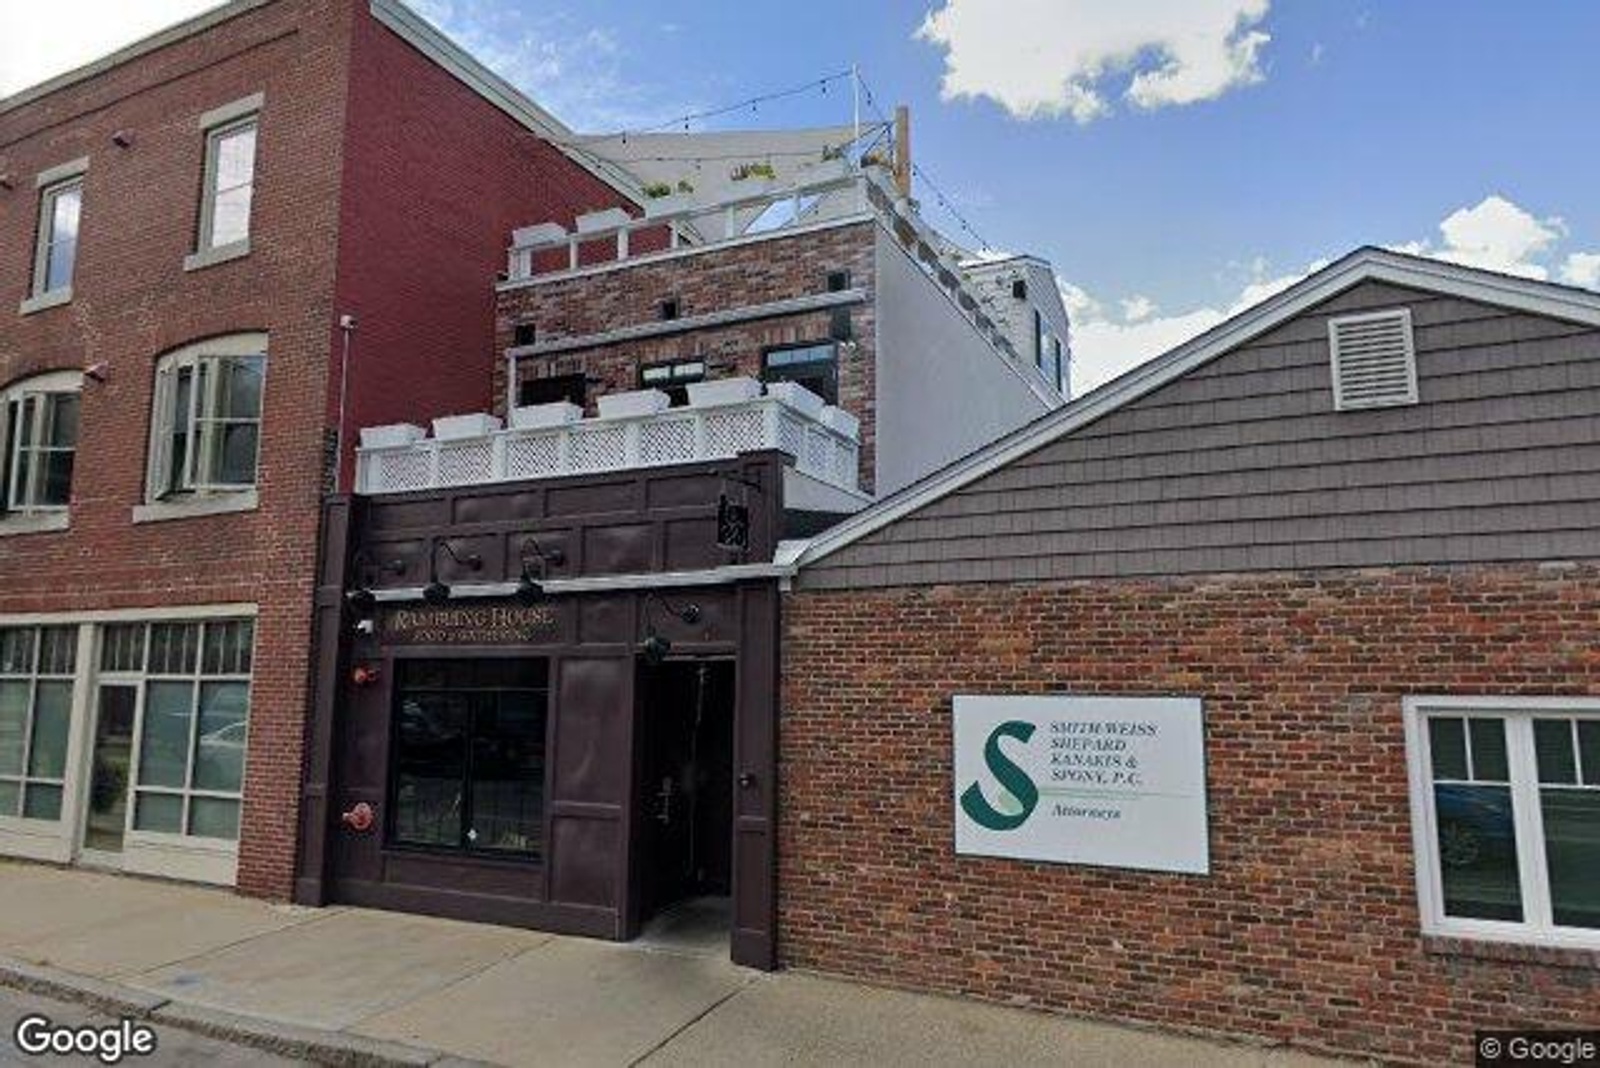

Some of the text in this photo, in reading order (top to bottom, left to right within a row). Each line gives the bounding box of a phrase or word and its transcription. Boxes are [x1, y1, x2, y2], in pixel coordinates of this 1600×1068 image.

[491, 606, 554, 628] HOUSE
[1050, 737, 1126, 752] SHEPARD
[1125, 755, 1138, 769] &
[1052, 804, 1121, 821] Attorneys
